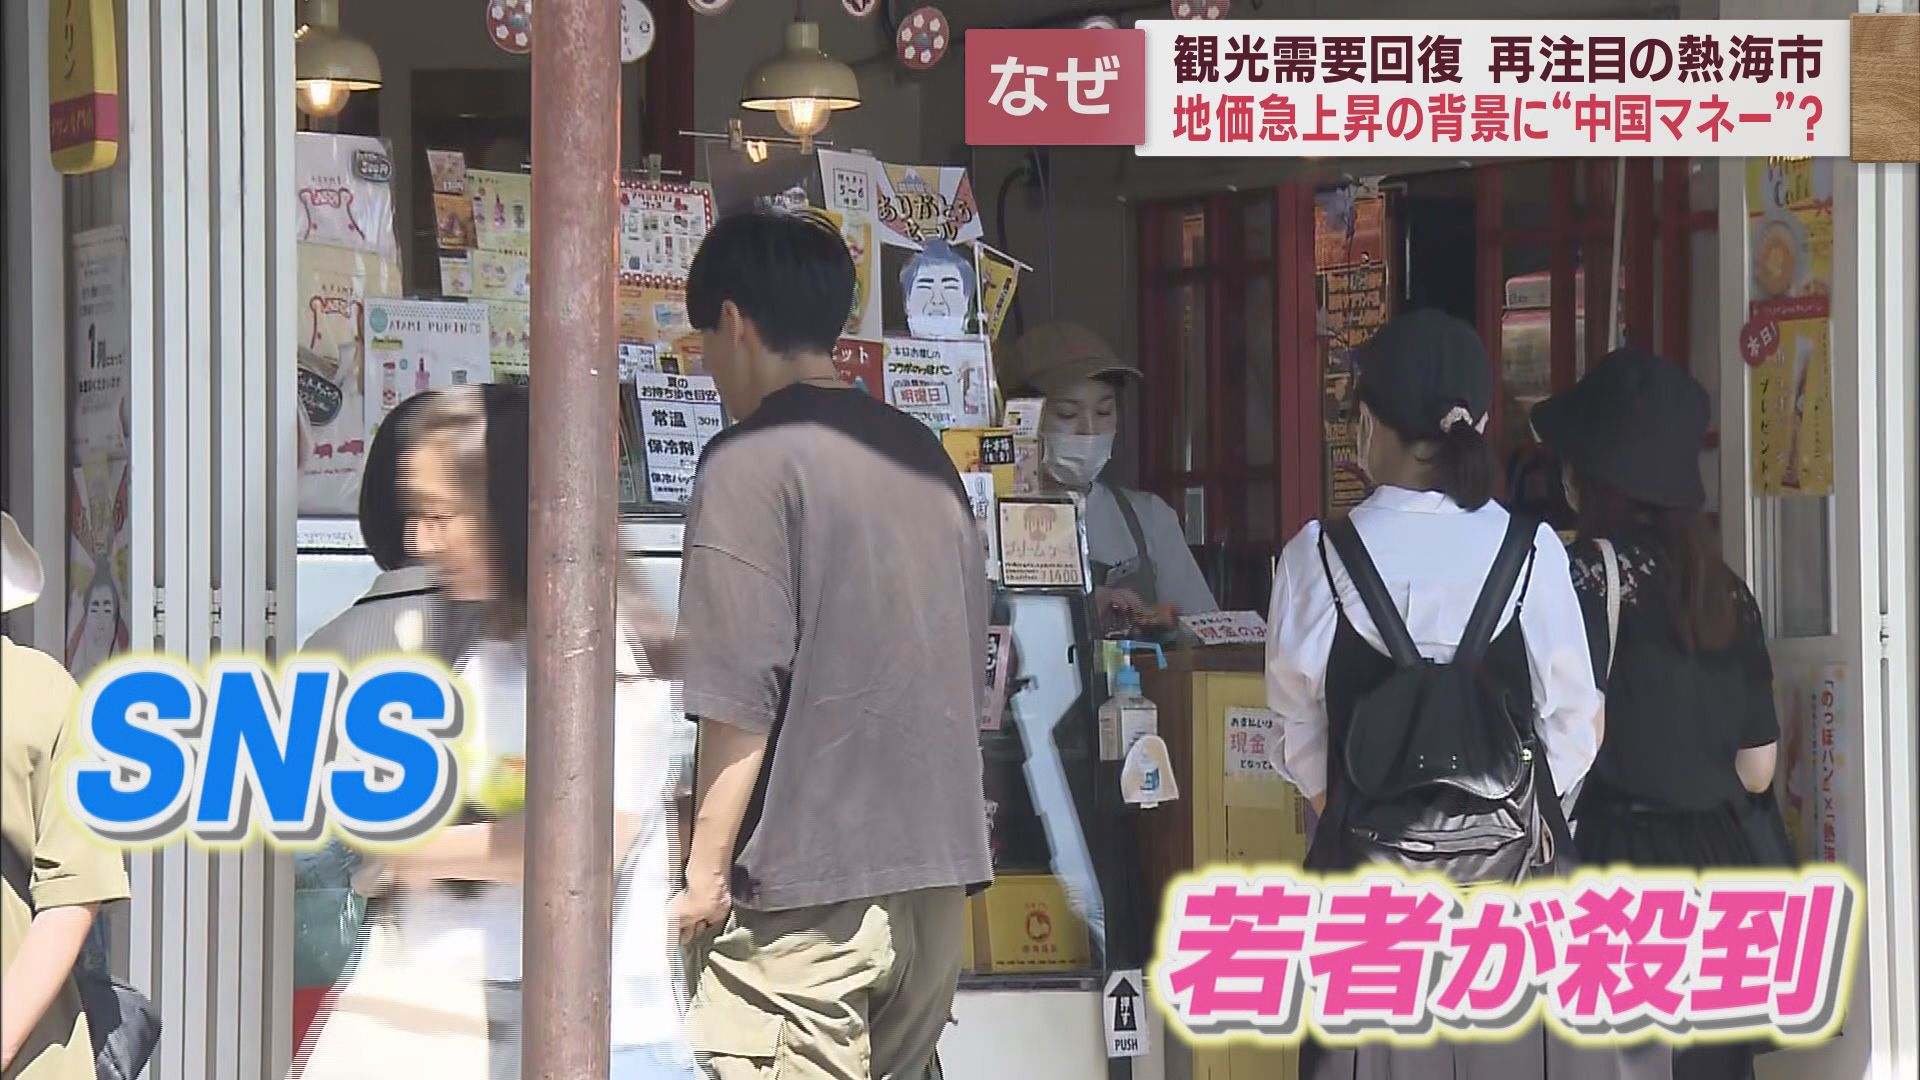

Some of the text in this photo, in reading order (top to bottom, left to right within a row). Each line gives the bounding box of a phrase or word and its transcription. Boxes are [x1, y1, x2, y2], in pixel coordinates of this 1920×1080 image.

[877, 192, 973, 223] ありがとう
[904, 217, 958, 242] セール
[667, 376, 688, 389] 夏の
[642, 385, 719, 402] お持ち歩き目安
[651, 408, 687, 428] 常温
[647, 438, 695, 456] 保冷剤
[1230, 731, 1266, 754] 現金
[1114, 1039, 1139, 1052] PUSH
